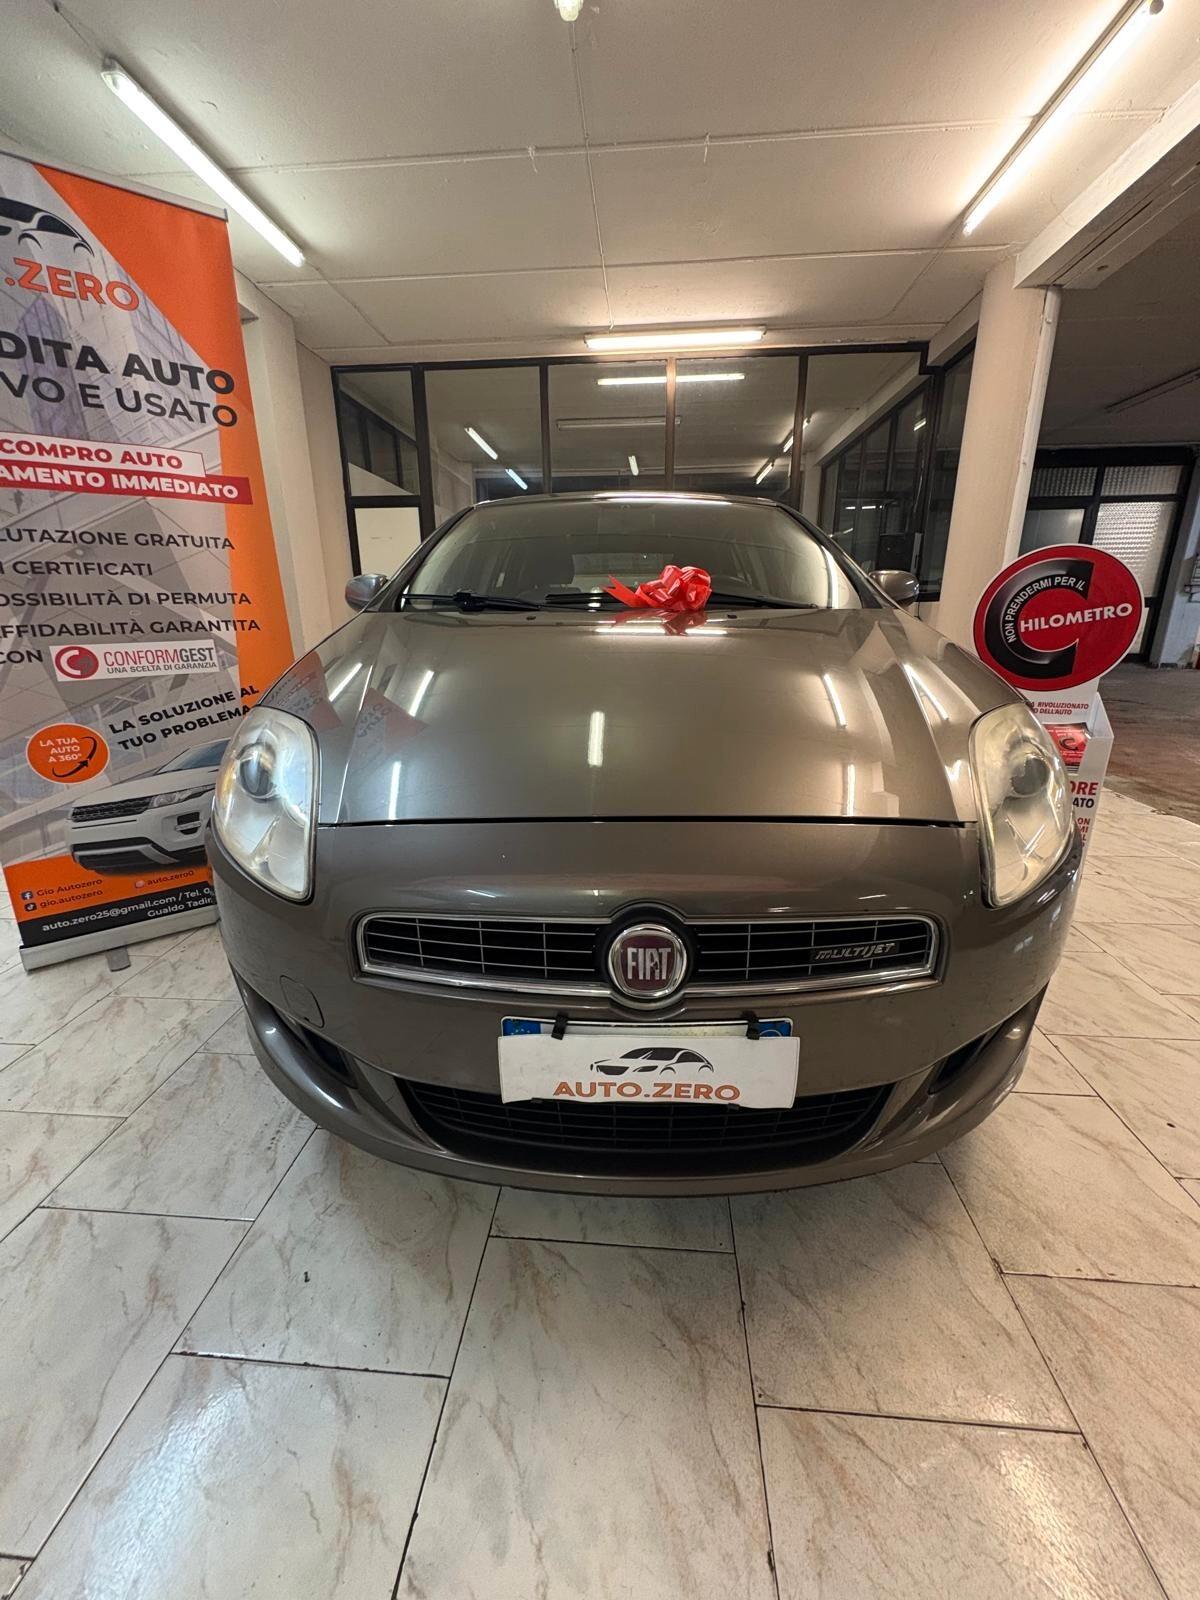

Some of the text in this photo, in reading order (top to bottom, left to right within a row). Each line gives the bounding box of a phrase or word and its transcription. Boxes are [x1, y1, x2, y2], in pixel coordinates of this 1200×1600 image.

[123, 353, 235, 394] AUTO
[79, 383, 104, 409] E
[115, 388, 237, 427] USATO
[0, 439, 183, 470] COMPRO AUTO
[111, 475, 239, 499] IMMEDIATO
[134, 533, 235, 549] GRATUITA
[12, 561, 153, 576] CERTIFICATI
[128, 593, 150, 605] DI
[156, 592, 251, 605] PERMUTA
[1004, 576, 1085, 643] NON PRENDERMI PER IL
[0, 618, 260, 638] FFIDABILITÀ GARANTITA
[103, 647, 214, 667] CONFORMGEST
[107, 661, 217, 674] UNA SCELTA DI GARANZIA
[109, 685, 260, 734] LA SOLUZIONE AL
[1038, 702, 1089, 710] RIVOLUZIONATO
[118, 705, 251, 750] TUO PROBLEMA
[39, 737, 79, 748] LA TUA
[50, 745, 80, 754] AUTO
[36, 879, 103, 897] Gio Autozero
[40, 890, 103, 909] gio.autozero
[42, 895, 176, 932] auto.zero25@gmail.com
[184, 889, 202, 899] Tel.
[147, 904, 185, 917] Gualdo
[813, 941, 896, 960] MULTIJET
[626, 947, 672, 981] FIAT
[552, 1081, 741, 1101] AUTO.ZERO
